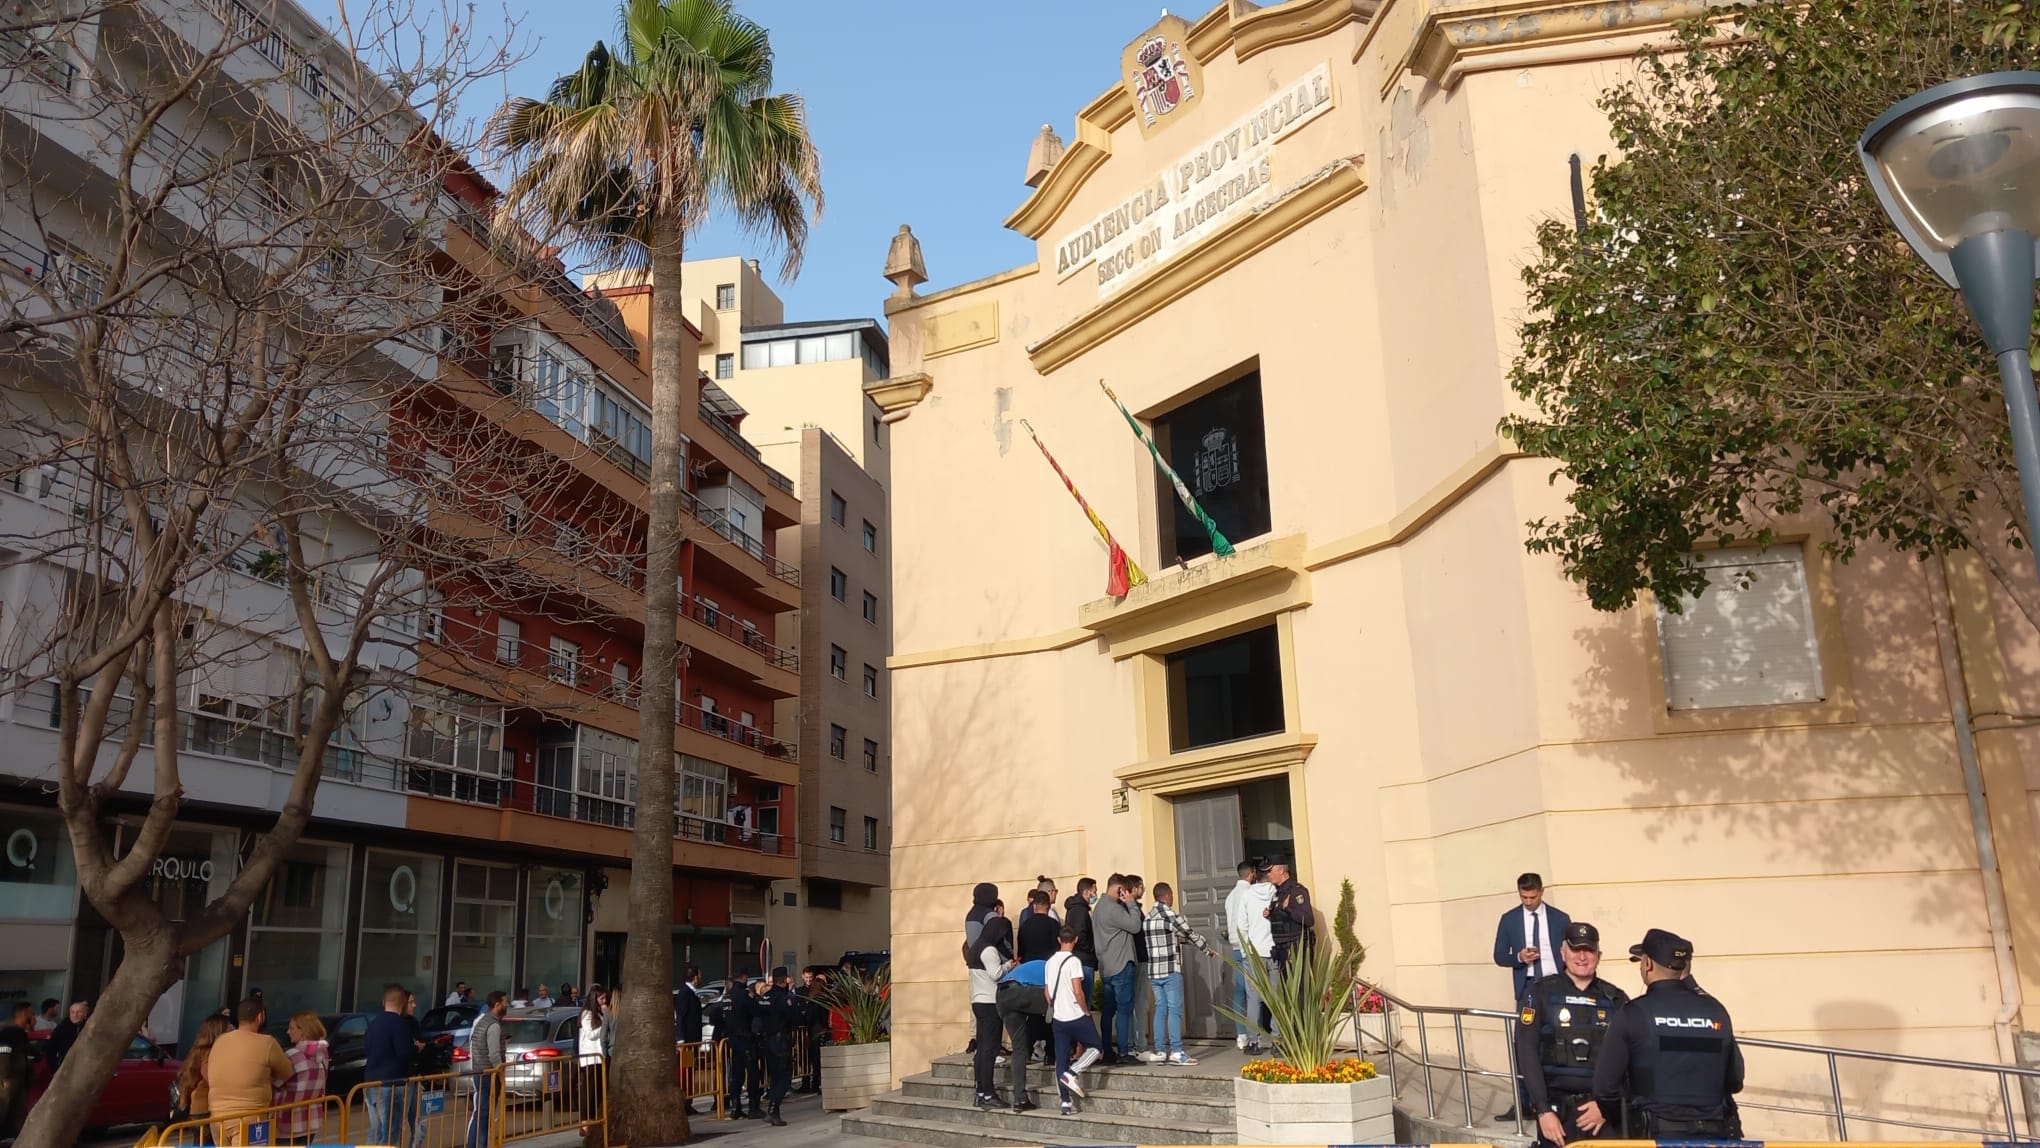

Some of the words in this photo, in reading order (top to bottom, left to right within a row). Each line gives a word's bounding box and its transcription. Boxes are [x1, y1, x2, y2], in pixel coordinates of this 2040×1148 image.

[1057, 179, 1169, 275] AUDIENCIA
[1180, 75, 1330, 194] PROVNCIAL
[1097, 226, 1162, 286] SECCON
[1173, 155, 1272, 240] ALGECIRAS
[147, 857, 215, 882] RQULO
[1654, 1016, 1714, 1030] POLICIA
